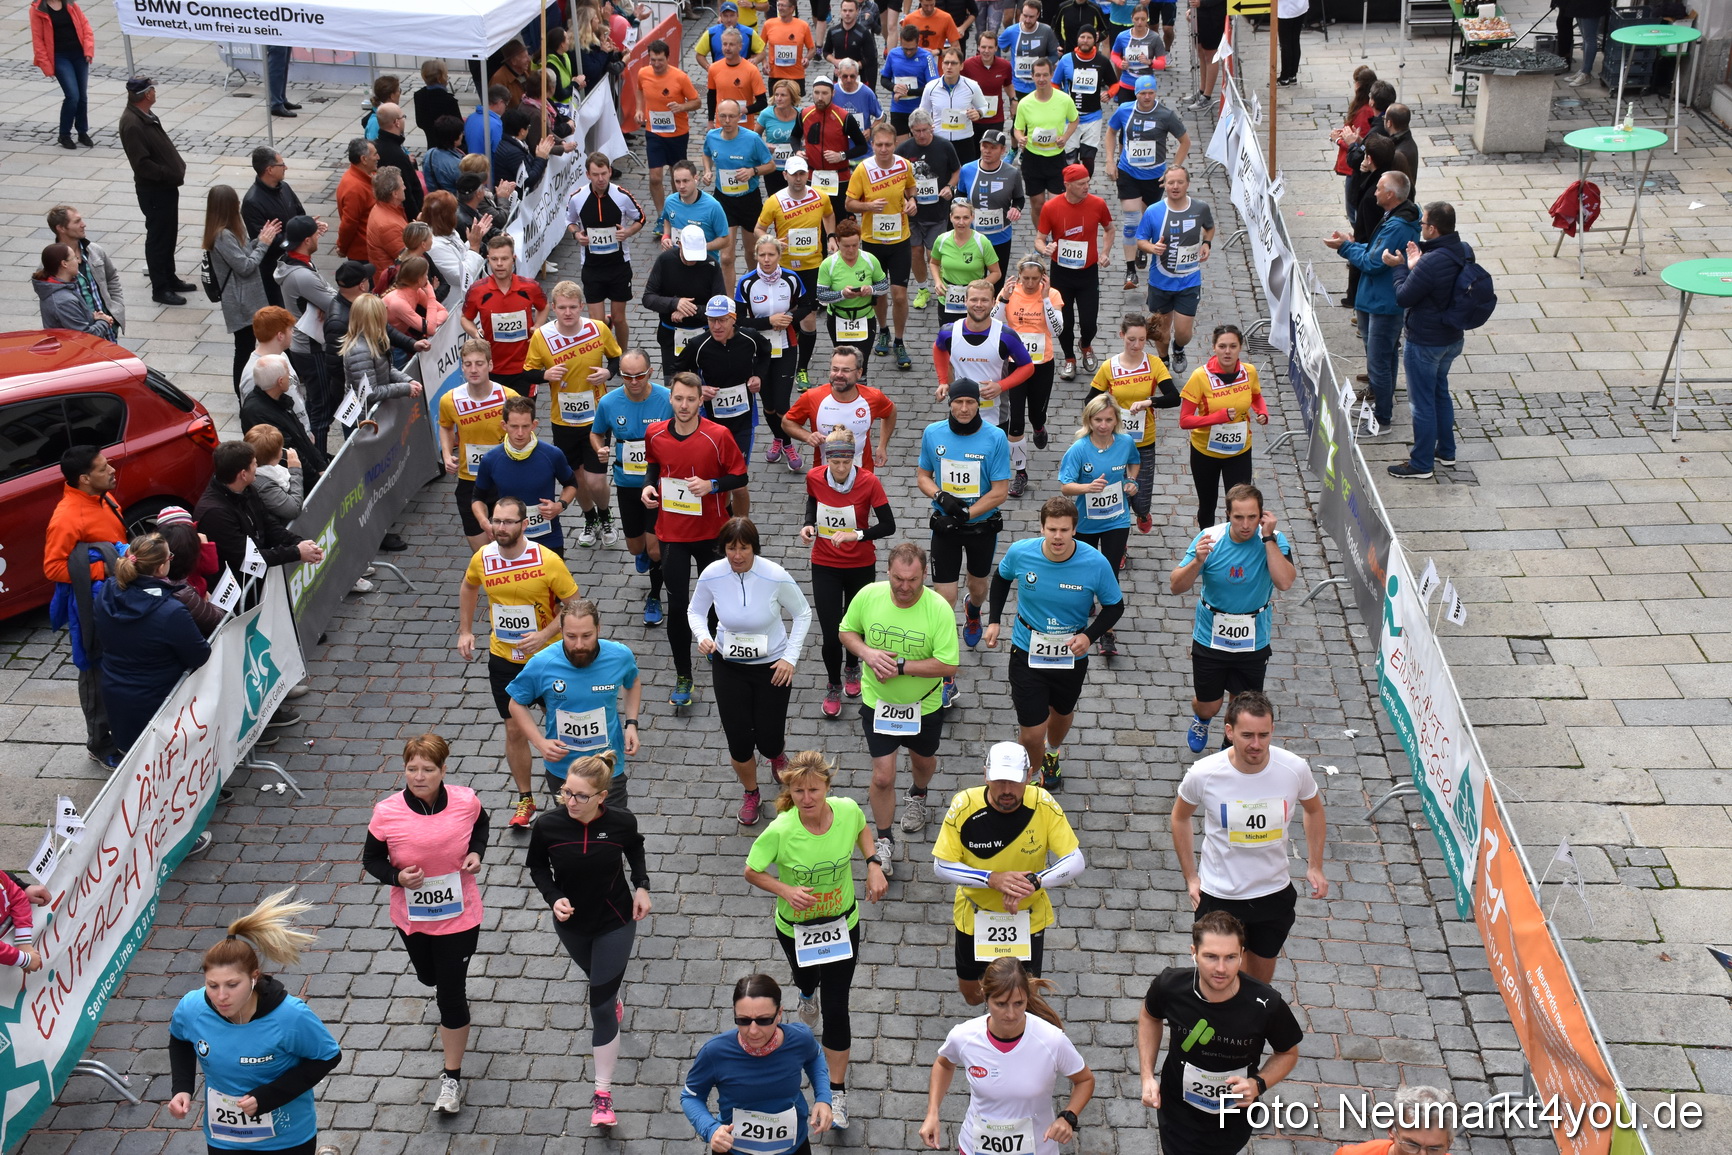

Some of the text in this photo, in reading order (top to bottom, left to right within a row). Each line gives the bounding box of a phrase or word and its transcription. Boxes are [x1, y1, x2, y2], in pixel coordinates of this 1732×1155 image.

[135, 0, 325, 25] BMW ConnectedDrive
[137, 15, 283, 37] Vernetzt, um frei zu sein.
[778, 51, 793, 60] 2091
[1076, 77, 1096, 86] 2152
[653, 117, 671, 125] 2068
[949, 115, 959, 124] 74
[1037, 135, 1052, 143] 207
[1132, 148, 1152, 158] 2017
[820, 178, 830, 186] 26
[871, 182, 890, 193] MAX
[916, 186, 935, 196] 2496
[784, 201, 825, 221] MAX BÖGL
[879, 222, 896, 231] 267
[979, 216, 1000, 226] 2516
[592, 235, 613, 244] 2411
[795, 236, 812, 246] 269
[1167, 220, 1181, 269] HIMATEC
[1061, 248, 1084, 260] 2018
[1181, 252, 1199, 264] 2195
[497, 320, 523, 332] 2223
[843, 320, 860, 331] 154
[554, 340, 604, 364] MAX BÖGL
[1114, 374, 1153, 387] MAX BÖGL
[1212, 383, 1251, 398] MAX BÖGL
[564, 400, 591, 412] 2626
[716, 393, 743, 409] 2174
[460, 415, 482, 427] MAX
[1214, 431, 1243, 444] 2635
[949, 470, 970, 485] 118
[677, 489, 685, 500] 7
[1091, 493, 1118, 507] 2078
[820, 515, 842, 528] 124
[485, 568, 546, 589] MAX BÖGL
[1059, 583, 1083, 591] BOCK
[219, 582, 234, 605] swn
[498, 616, 531, 630] 2609
[1046, 617, 1060, 627] 18.
[1218, 624, 1250, 639] 2400
[729, 643, 760, 659] 2561
[1036, 642, 1069, 656] 2119
[591, 683, 615, 693] BOCK
[881, 704, 914, 720] 2090
[564, 721, 600, 738] 2015
[890, 722, 904, 731] Sepp
[573, 738, 593, 746] Markus
[1246, 814, 1267, 830] 40
[1245, 832, 1268, 841] Michael
[968, 840, 1005, 849] Bernd W.
[36, 847, 53, 875] swn
[413, 887, 454, 905] 2084
[427, 906, 443, 915] Petra
[802, 928, 842, 947] 2203
[987, 926, 1018, 943] 233
[817, 947, 831, 956] Gabi
[994, 946, 1012, 954] Bernd
[87, 939, 137, 1022] Service-Line:
[1526, 970, 1541, 1000] für die
[1535, 965, 1558, 1015] Neumarkts
[239, 1055, 275, 1066] BOCK
[741, 1121, 788, 1141] 2916
[980, 1134, 1025, 1154] 2607
